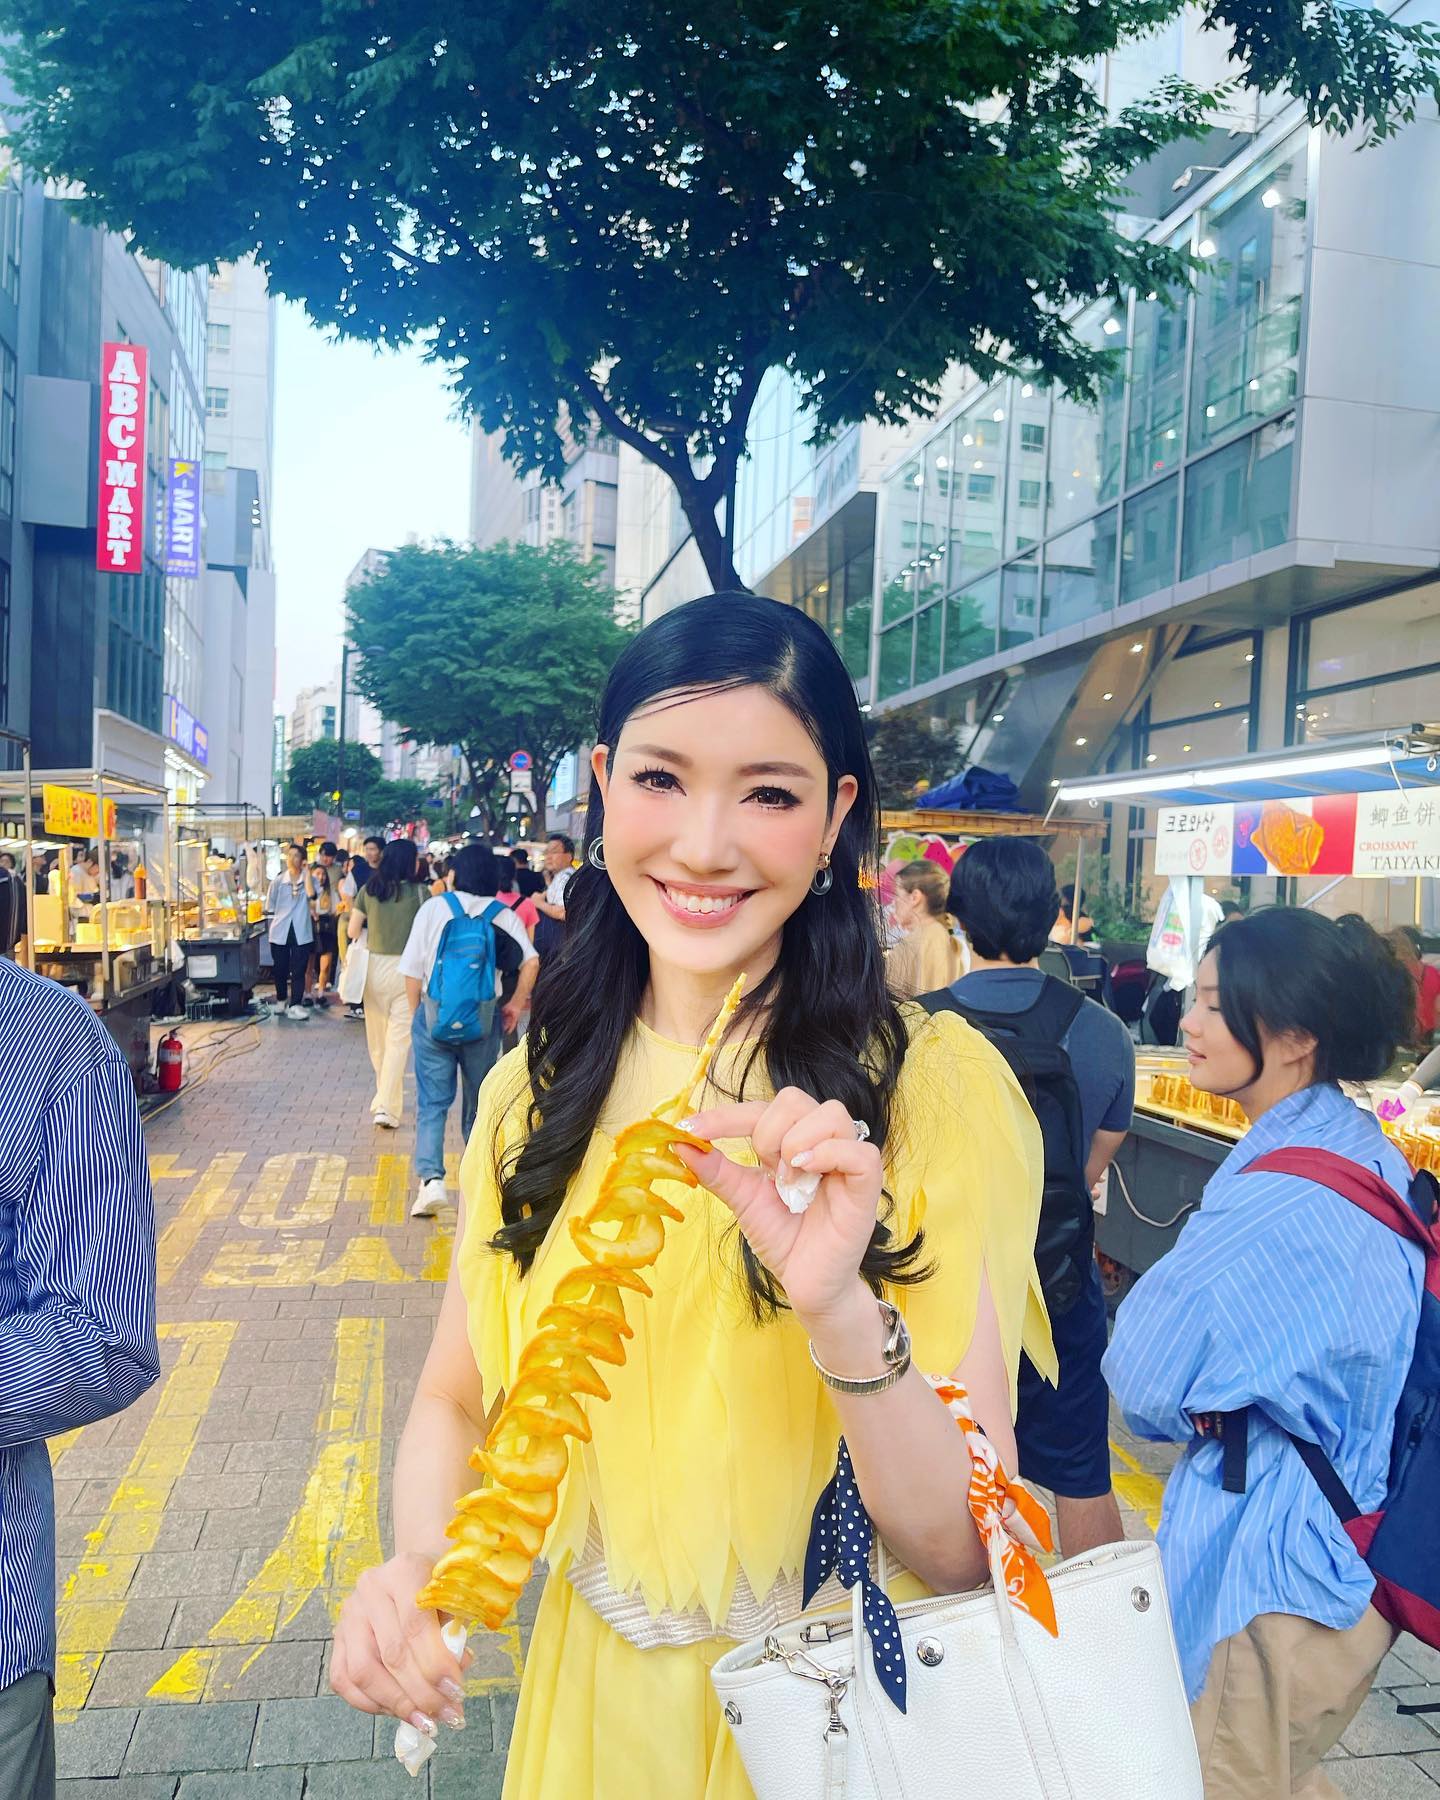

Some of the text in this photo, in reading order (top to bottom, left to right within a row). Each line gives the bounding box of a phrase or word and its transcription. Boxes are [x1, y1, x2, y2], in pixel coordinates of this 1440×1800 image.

[106, 351, 140, 566] ABC-MART
[172, 462, 194, 558] K-MART
[1165, 812, 1215, 832] 크로와상
[1359, 841, 1418, 852] CROISSANT
